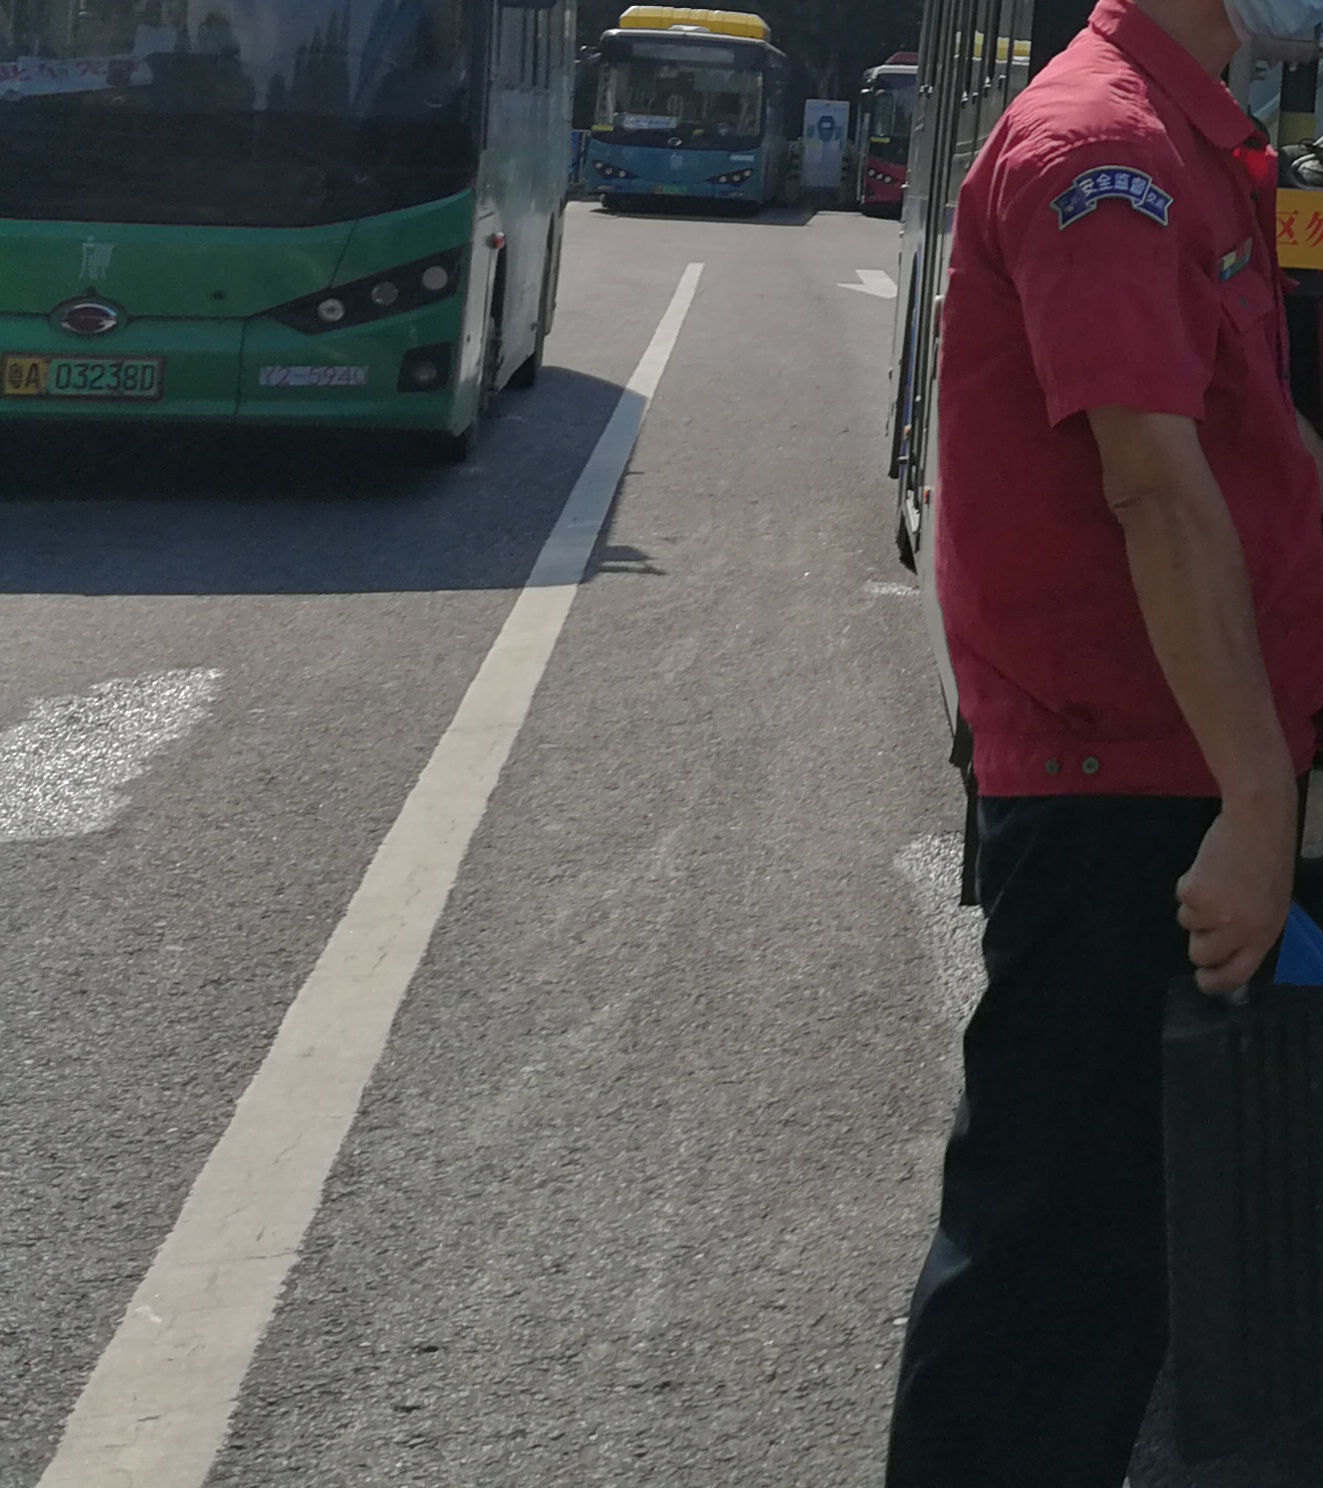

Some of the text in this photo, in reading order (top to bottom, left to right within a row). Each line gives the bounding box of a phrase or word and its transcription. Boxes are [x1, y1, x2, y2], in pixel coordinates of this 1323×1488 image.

[1079, 172, 1148, 196] 安全监督
[55, 363, 155, 391] 03238D
